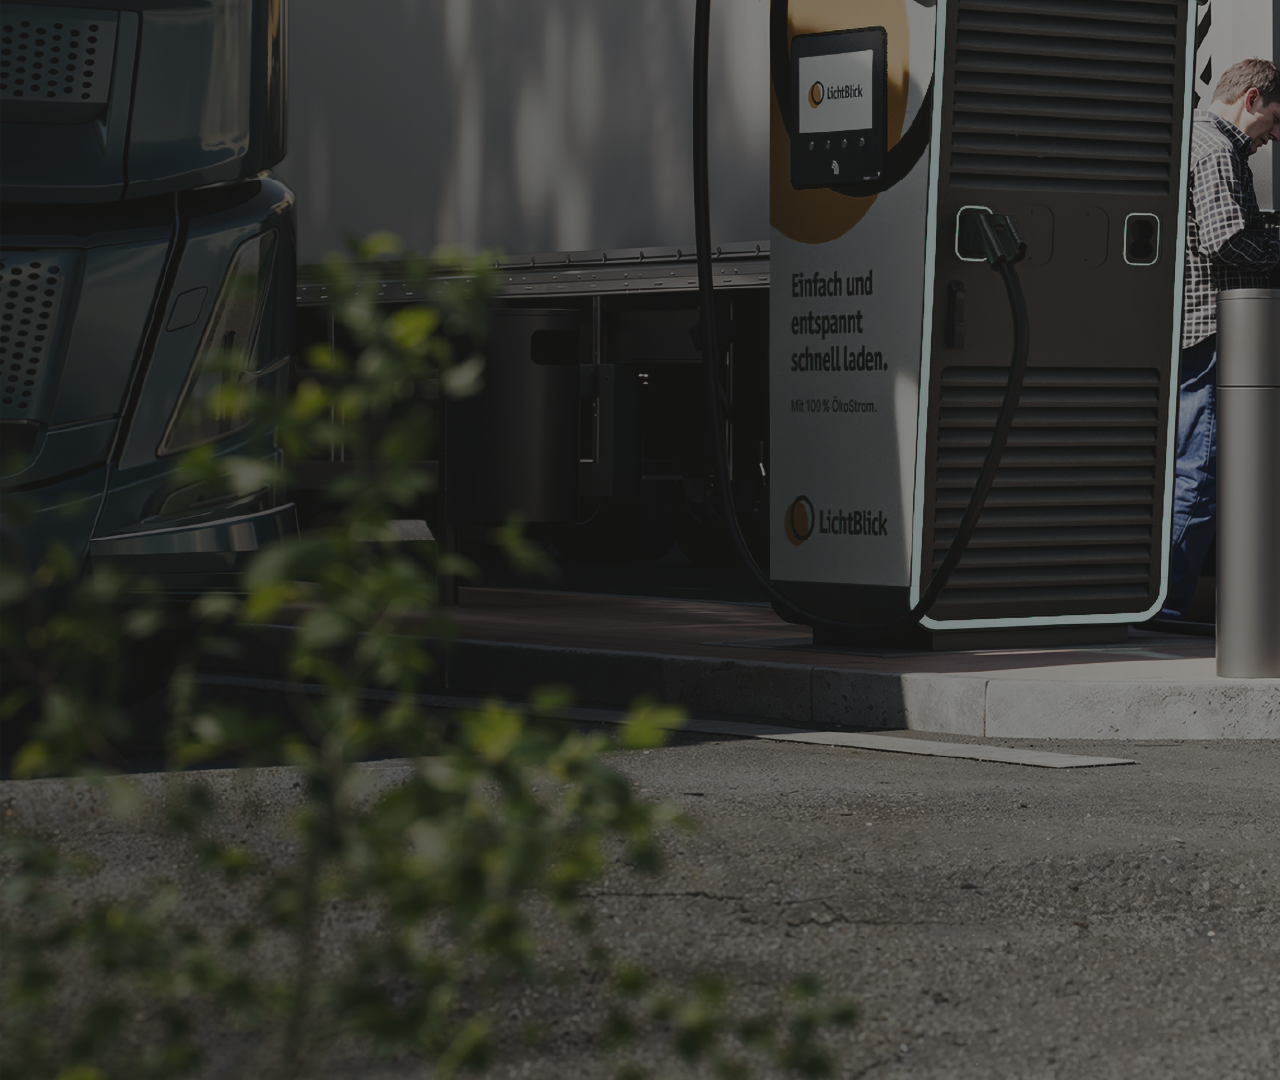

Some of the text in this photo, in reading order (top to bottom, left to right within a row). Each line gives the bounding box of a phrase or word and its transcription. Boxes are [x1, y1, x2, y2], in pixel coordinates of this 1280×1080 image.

[827, 84, 863, 100] LichtBlick
[792, 269, 873, 298] Einfach und
[791, 310, 863, 340] entspannt
[791, 345, 888, 372] schnell laden.
[791, 396, 877, 413] Mit 100 % ÖkoStrom.
[819, 509, 888, 537] LichtBlick
